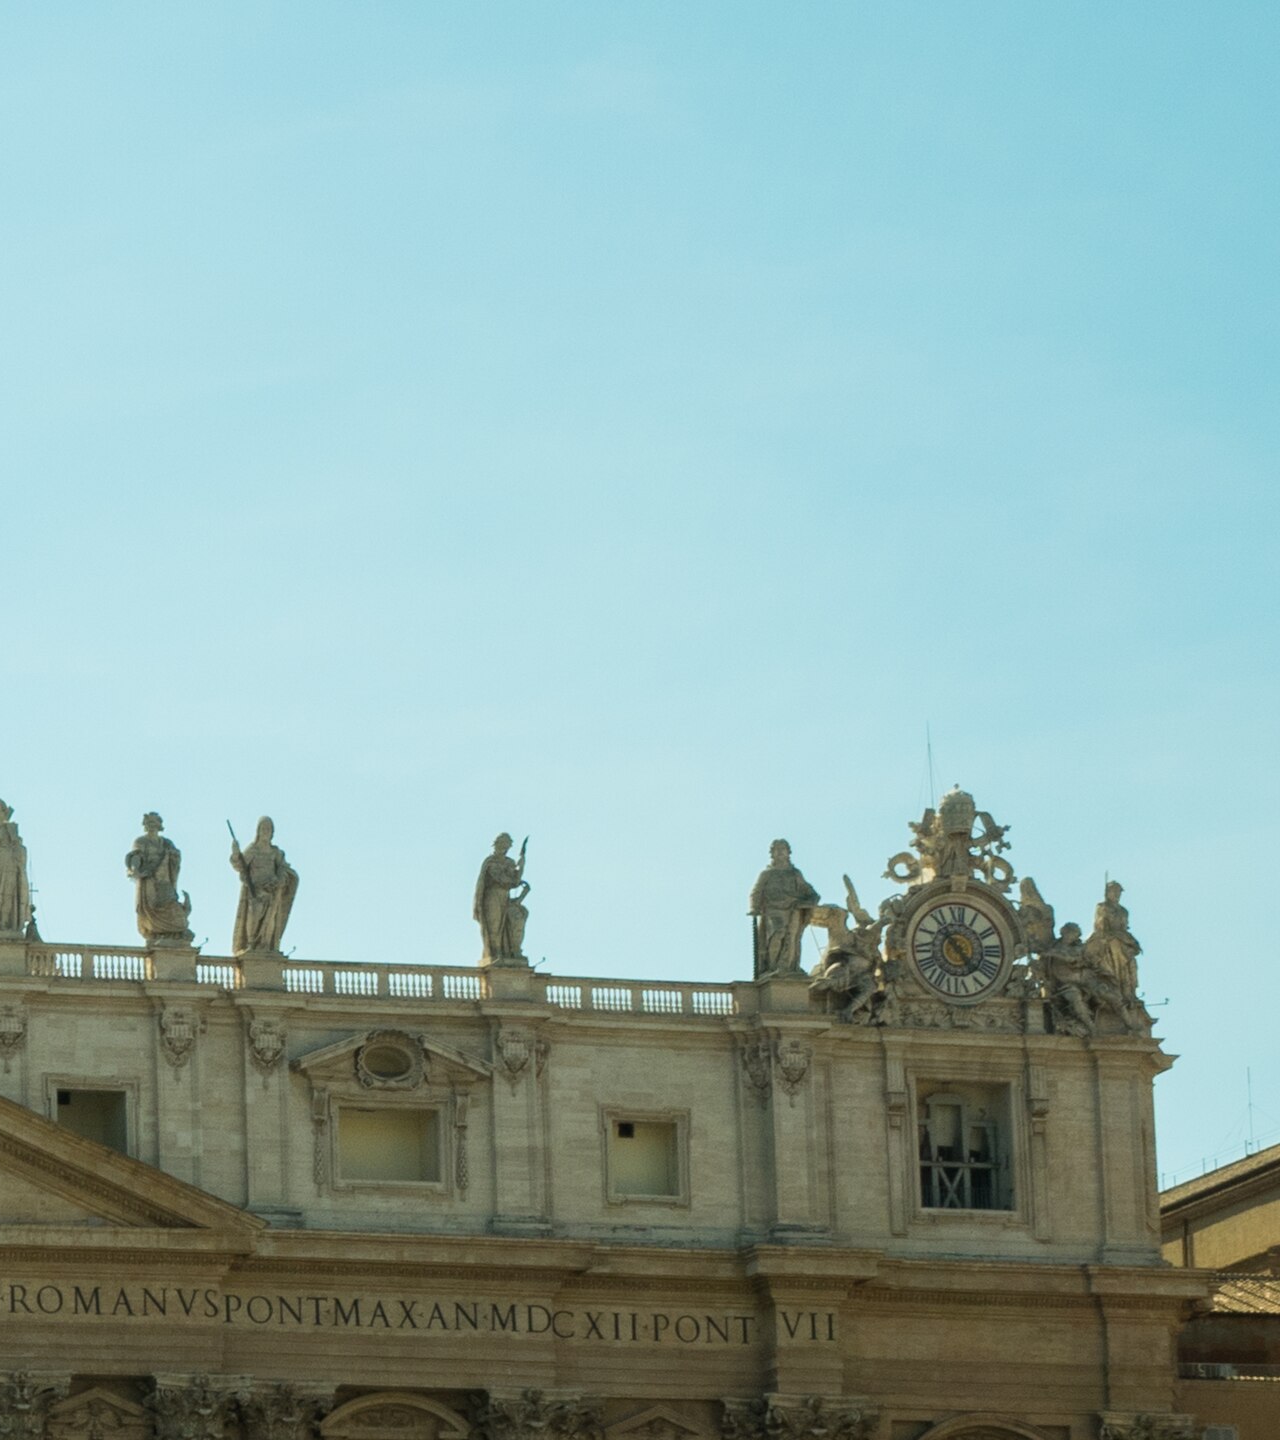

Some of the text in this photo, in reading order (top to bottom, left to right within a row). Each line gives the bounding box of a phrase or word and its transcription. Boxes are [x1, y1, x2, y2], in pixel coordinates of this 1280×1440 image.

[7, 1284, 220, 1319] ROMANVS
[221, 1296, 329, 1326] PONT
[330, 1298, 420, 1330] MAX
[421, 1302, 481, 1333] AN
[489, 1303, 639, 1341] MDCXII
[652, 1313, 756, 1345] PONT
[781, 1311, 837, 1342] VII
